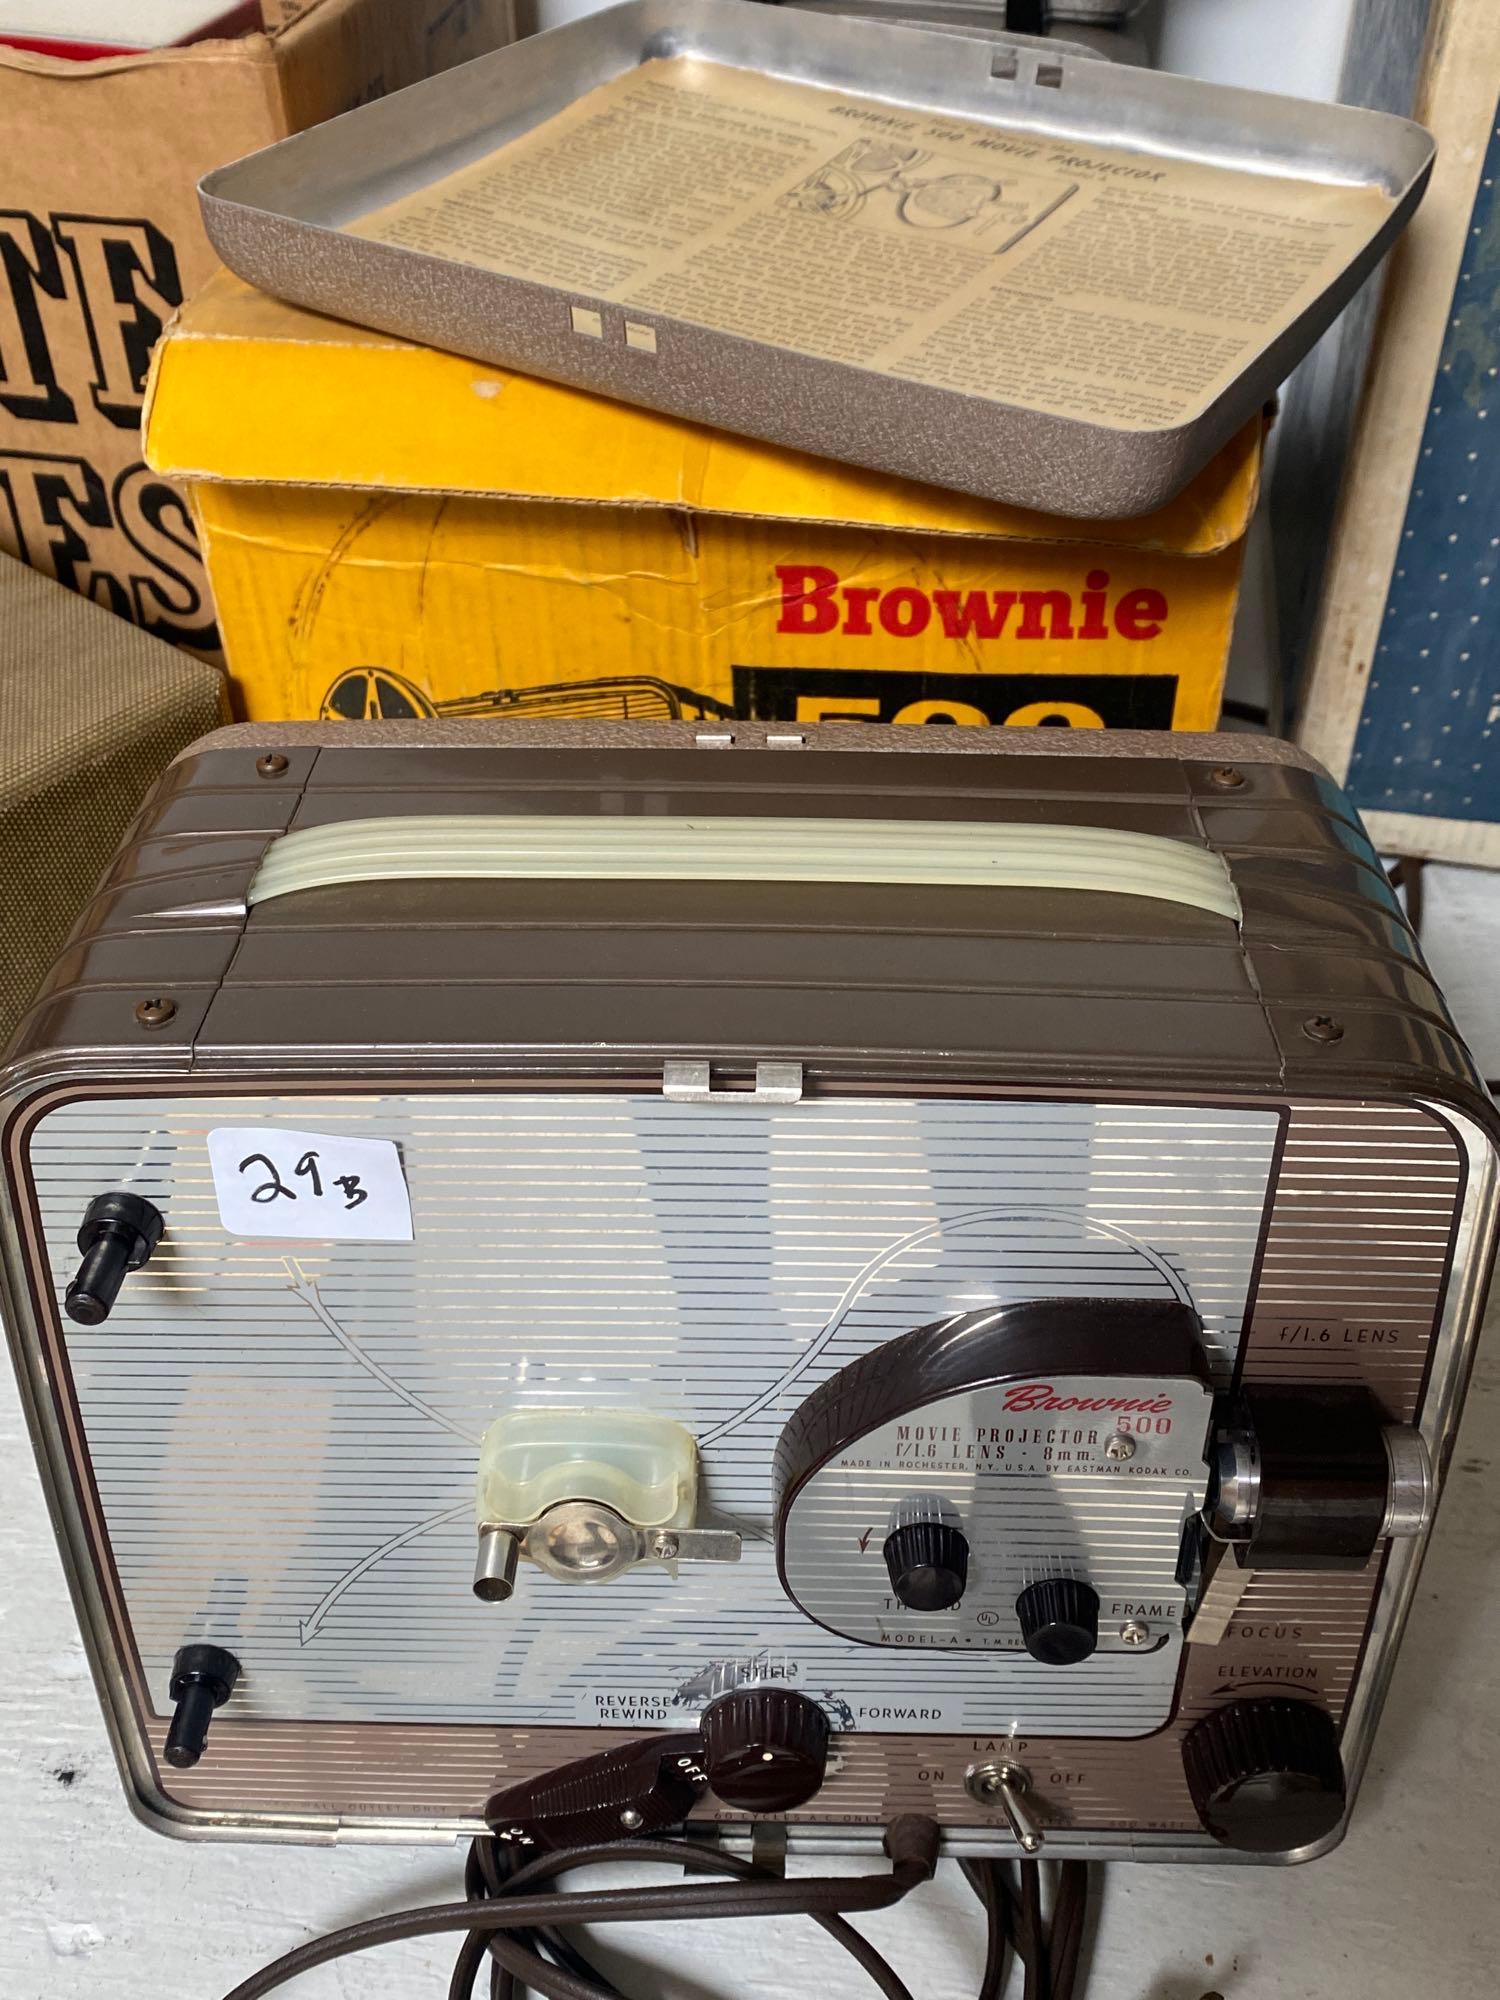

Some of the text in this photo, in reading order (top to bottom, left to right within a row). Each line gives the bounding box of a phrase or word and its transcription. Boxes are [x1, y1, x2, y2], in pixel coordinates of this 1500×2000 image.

[828, 105, 919, 131] BROWNIE
[925, 127, 966, 143] 500
[974, 137, 1042, 161] MOVIE
[1048, 152, 1168, 184] PROJECTOR
[774, 564, 1170, 641] Brownie
[1279, 1325, 1400, 1344] f/1.6 LENS
[1002, 1384, 1173, 1414] Brownie
[1115, 1415, 1172, 1435] 500
[897, 1426, 1099, 1445] MOVIE PROJECTOR
[951, 1444, 1006, 1460] LENS
[841, 1459, 872, 1468] MADE
[880, 1460, 891, 1468] IN
[899, 1460, 969, 1471] ROCHESTER,
[1046, 1464, 1059, 1473] BY
[1067, 1465, 1121, 1474] EASTMAN
[1128, 1466, 1168, 1476] KODAK
[1175, 1468, 1193, 1477] CO.
[1112, 1603, 1177, 1617] FRAME
[1226, 1626, 1304, 1640] FOCUS
[1217, 1665, 1319, 1679] ELEVATION
[595, 1695, 671, 1707] REVERSE
[600, 1708, 667, 1720] REWIND
[859, 1707, 943, 1720] FORWARD
[973, 1741, 1028, 1752] LAMP
[677, 1757, 708, 1783] OFF
[918, 1771, 945, 1781] ON
[1050, 1773, 1087, 1784] OFF
[509, 1827, 535, 1845] ON
